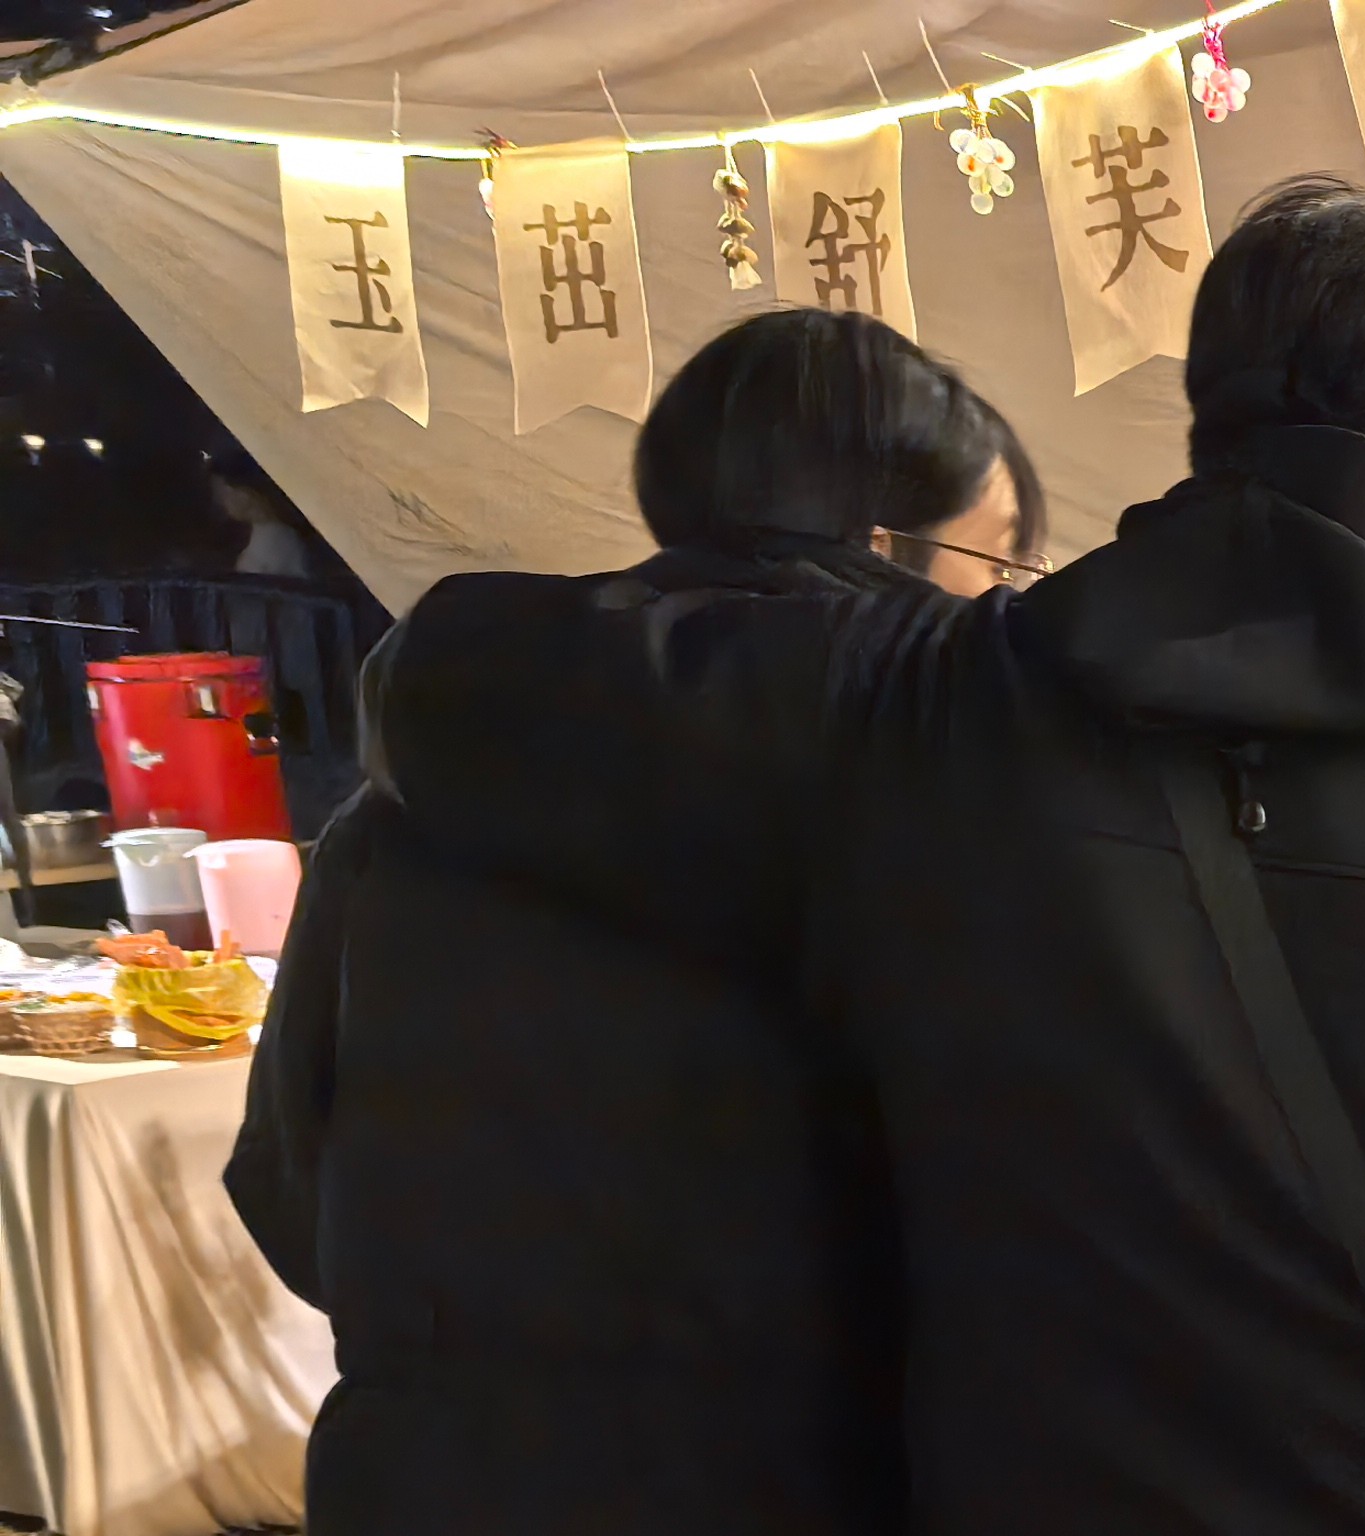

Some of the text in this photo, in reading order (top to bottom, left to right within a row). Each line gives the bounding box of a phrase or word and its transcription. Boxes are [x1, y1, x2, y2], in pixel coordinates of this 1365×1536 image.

[324, 211, 403, 333] 玉
[522, 201, 618, 344] 茁
[805, 187, 891, 315] 舒
[1071, 125, 1189, 292] 芙
